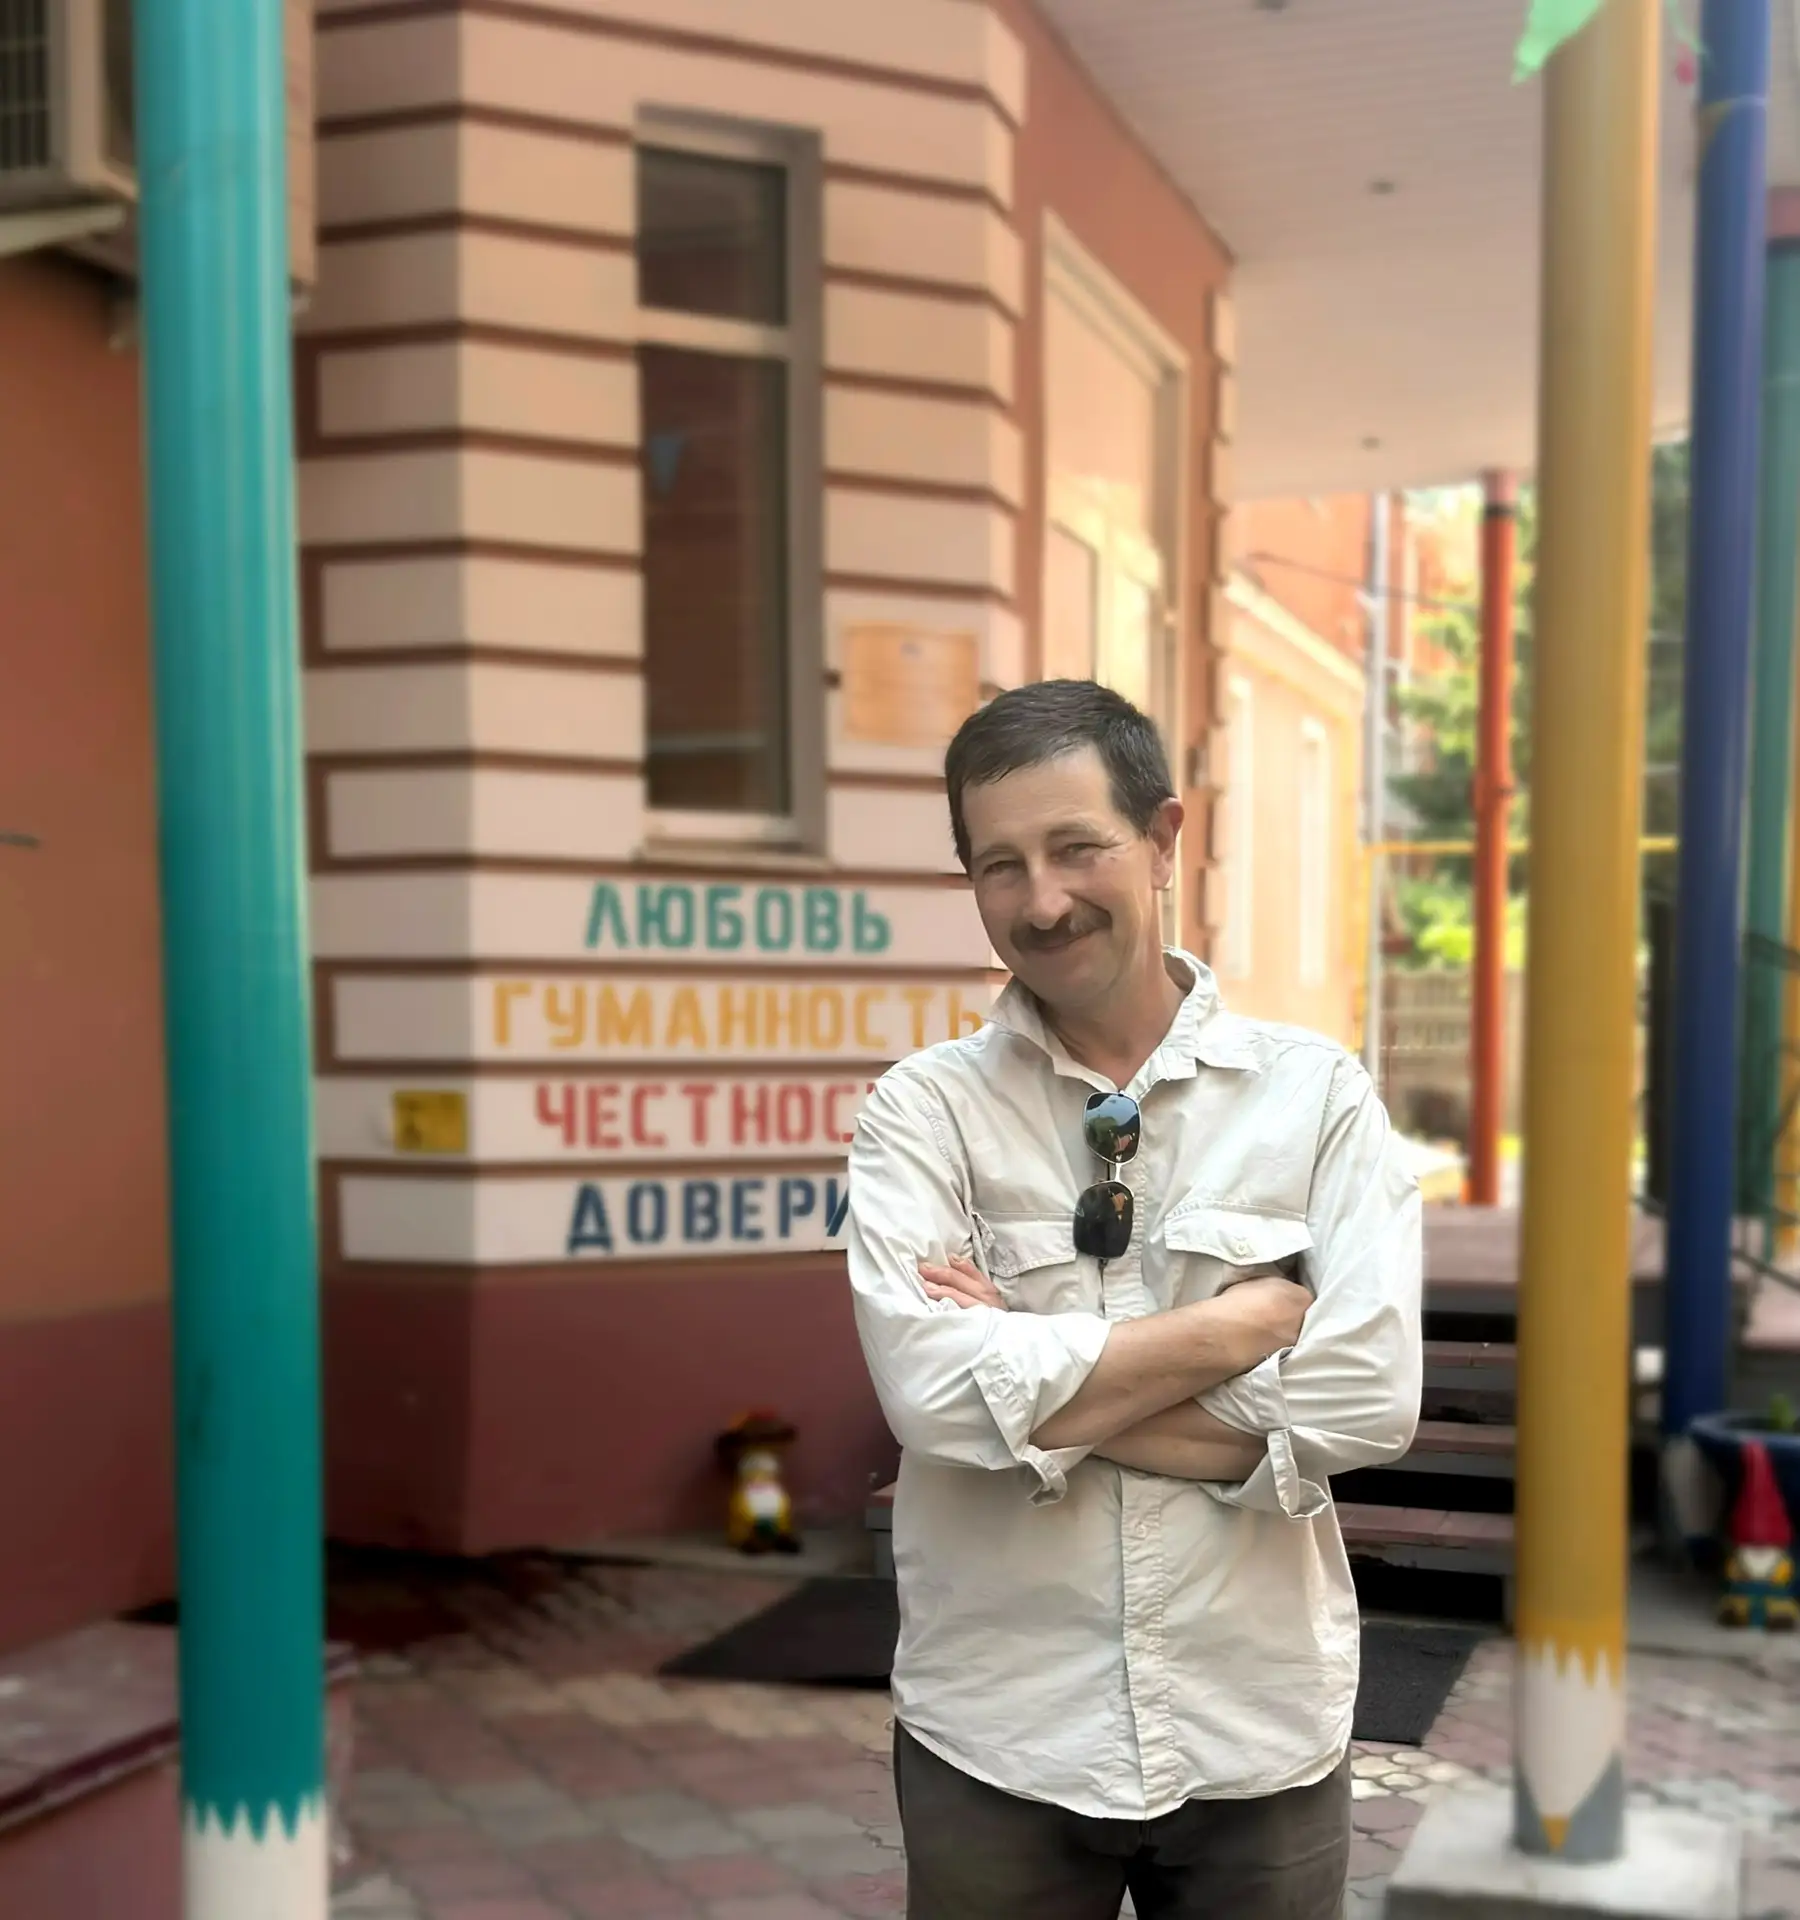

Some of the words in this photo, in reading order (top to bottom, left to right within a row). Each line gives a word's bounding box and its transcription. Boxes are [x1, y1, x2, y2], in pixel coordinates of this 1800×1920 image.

[584, 883, 891, 952] ЛЮБОВЬ
[493, 982, 983, 1048] ГУМАННОСТЬ
[535, 1083, 876, 1148] ЧЕСТНОС
